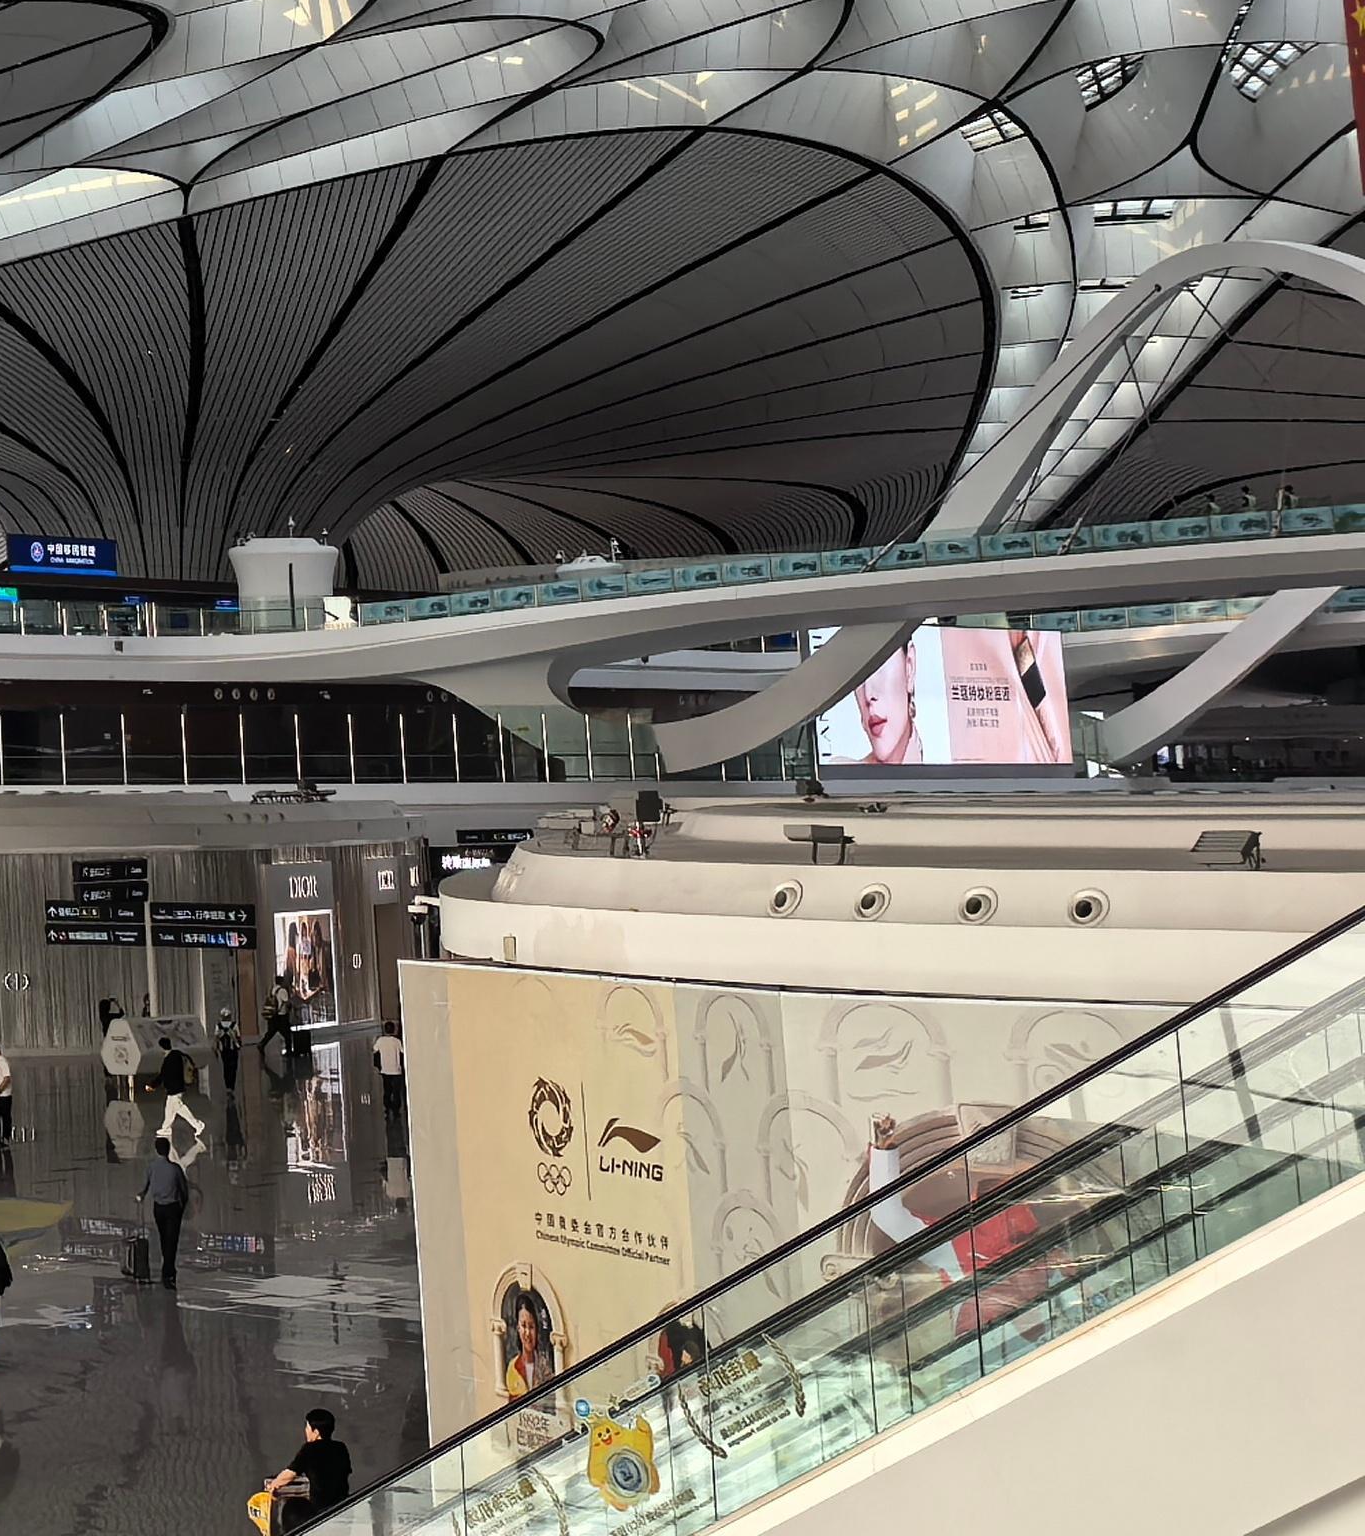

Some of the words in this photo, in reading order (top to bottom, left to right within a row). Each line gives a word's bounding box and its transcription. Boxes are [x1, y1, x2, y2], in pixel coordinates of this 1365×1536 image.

[289, 875, 318, 898] DIOR
[599, 1155, 664, 1182] LI-NING
[535, 1212, 669, 1250] 中国奥委会官方合作伙伴
[536, 1230, 559, 1243] Chinese
[560, 1233, 585, 1248] Olympic
[586, 1240, 620, 1255] Committee
[621, 1246, 644, 1260] Official
[645, 1251, 670, 1265] Partner
